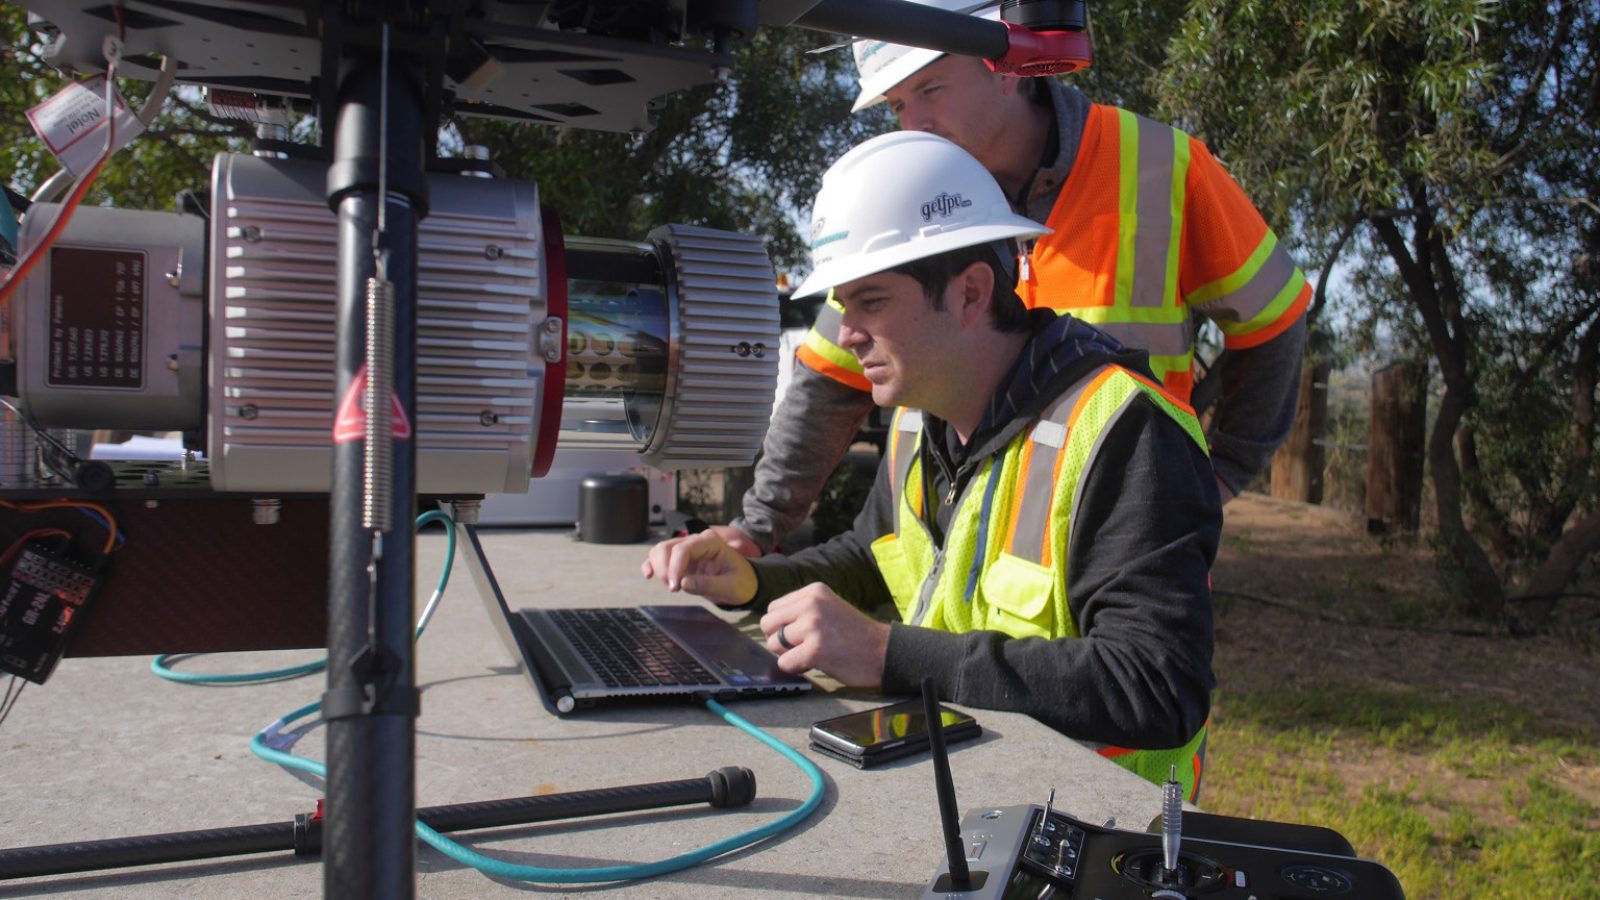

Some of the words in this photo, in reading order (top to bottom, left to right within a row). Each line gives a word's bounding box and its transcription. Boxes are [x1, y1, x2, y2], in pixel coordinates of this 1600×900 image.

[53, 294, 62, 324] Patents
[53, 328, 63, 338] by
[53, 342, 62, 379] Protected
[82, 366, 93, 377] US
[99, 366, 109, 378] US
